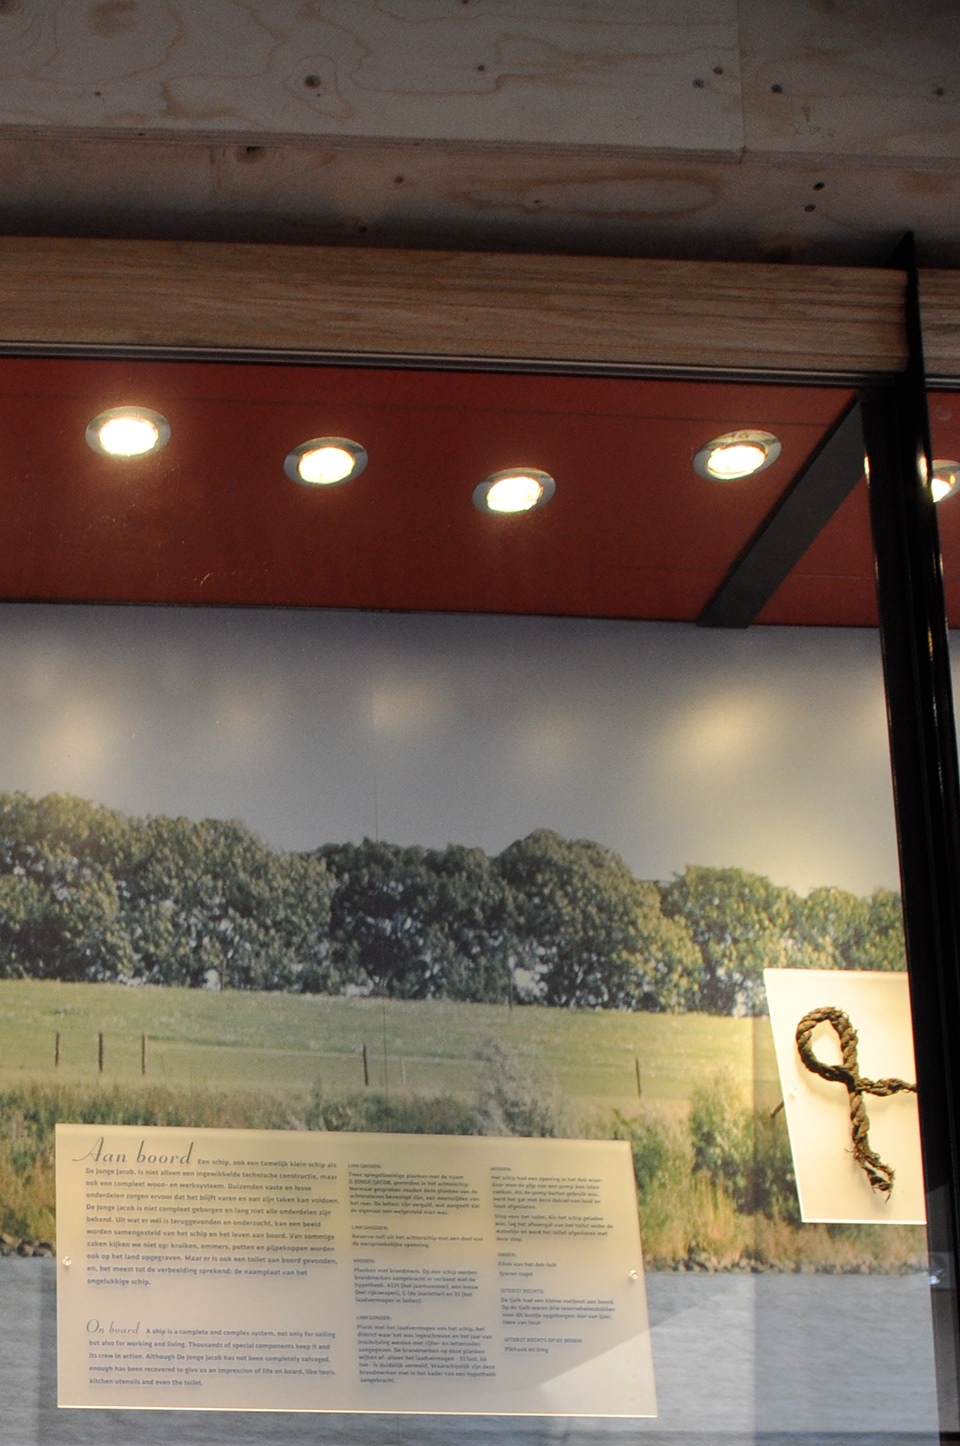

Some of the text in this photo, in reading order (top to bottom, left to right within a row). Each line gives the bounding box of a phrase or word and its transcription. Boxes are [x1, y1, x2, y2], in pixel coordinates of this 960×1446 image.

[72, 1136, 127, 1162] Aan
[137, 1140, 194, 1164] boord
[197, 1157, 210, 1165] Een
[232, 1158, 245, 1166] ook
[260, 1159, 288, 1169] tamelijk
[289, 1160, 306, 1168] klein
[308, 1160, 326, 1170] schip
[85, 1166, 94, 1174] De
[145, 1168, 158, 1176] niet
[160, 1168, 180, 1176] alleen
[196, 1169, 240, 1179] ingewikkelde
[241, 1170, 278, 1179] technische
[85, 1178, 98, 1186] ook
[113, 1179, 145, 1189] compleet
[227, 1182, 263, 1190] Duizenden
[86, 1190, 124, 1198] onderdelen
[126, 1193, 148, 1201] zorgen
[173, 1192, 185, 1200] dat
[186, 1192, 198, 1200] het
[199, 1193, 216, 1202] blijft
[262, 1194, 274, 1204] zijn
[275, 1195, 295, 1203] taken
[296, 1195, 309, 1203] kan
[86, 1202, 95, 1210] De
[136, 1203, 142, 1211] is
[158, 1204, 190, 1214] compleet
[191, 1205, 223, 1215] geborgen
[234, 1206, 249, 1215] lang
[250, 1206, 264, 1214] niet
[278, 1207, 317, 1215] onderdelen
[318, 1208, 331, 1218] zijn
[115, 1215, 125, 1223] Uit
[163, 1216, 169, 1224] is
[170, 1216, 221, 1227] teruggevonden
[274, 1219, 287, 1227] kan
[302, 1220, 321, 1228] beeld
[113, 1227, 161, 1238] samengesteld
[189, 1229, 207, 1239] schip
[218, 1230, 230, 1238] het
[231, 1230, 250, 1238] leven
[86, 1251, 99, 1259] ook
[101, 1253, 110, 1261] op
[111, 1252, 122, 1260] het
[124, 1252, 140, 1260] land
[184, 1253, 202, 1261] Maar
[211, 1254, 217, 1262] is
[218, 1254, 231, 1262] ook
[247, 1255, 266, 1263] toilet
[280, 1256, 301, 1264] boord
[99, 1264, 110, 1272] het
[146, 1265, 155, 1273] de
[156, 1265, 197, 1275] verbeelding
[243, 1267, 280, 1277] naamplaat
[295, 1268, 307, 1276] het
[86, 1276, 129, 1286] ongelukkige
[86, 1319, 104, 1334] On
[109, 1321, 140, 1335] board
[152, 1326, 166, 1336] ship
[167, 1326, 172, 1334] is
[179, 1327, 208, 1337] complete
[288, 1329, 303, 1339] only
[304, 1329, 313, 1337] for
[88, 1350, 97, 1358] its
[114, 1351, 121, 1359] in
[145, 1351, 175, 1362] Although
[176, 1352, 185, 1360] De
[223, 1353, 234, 1361] has
[248, 1353, 264, 1361] been
[89, 1376, 113, 1384] kitchen
[114, 1376, 140, 1384] utensils
[171, 1377, 183, 1385] the
